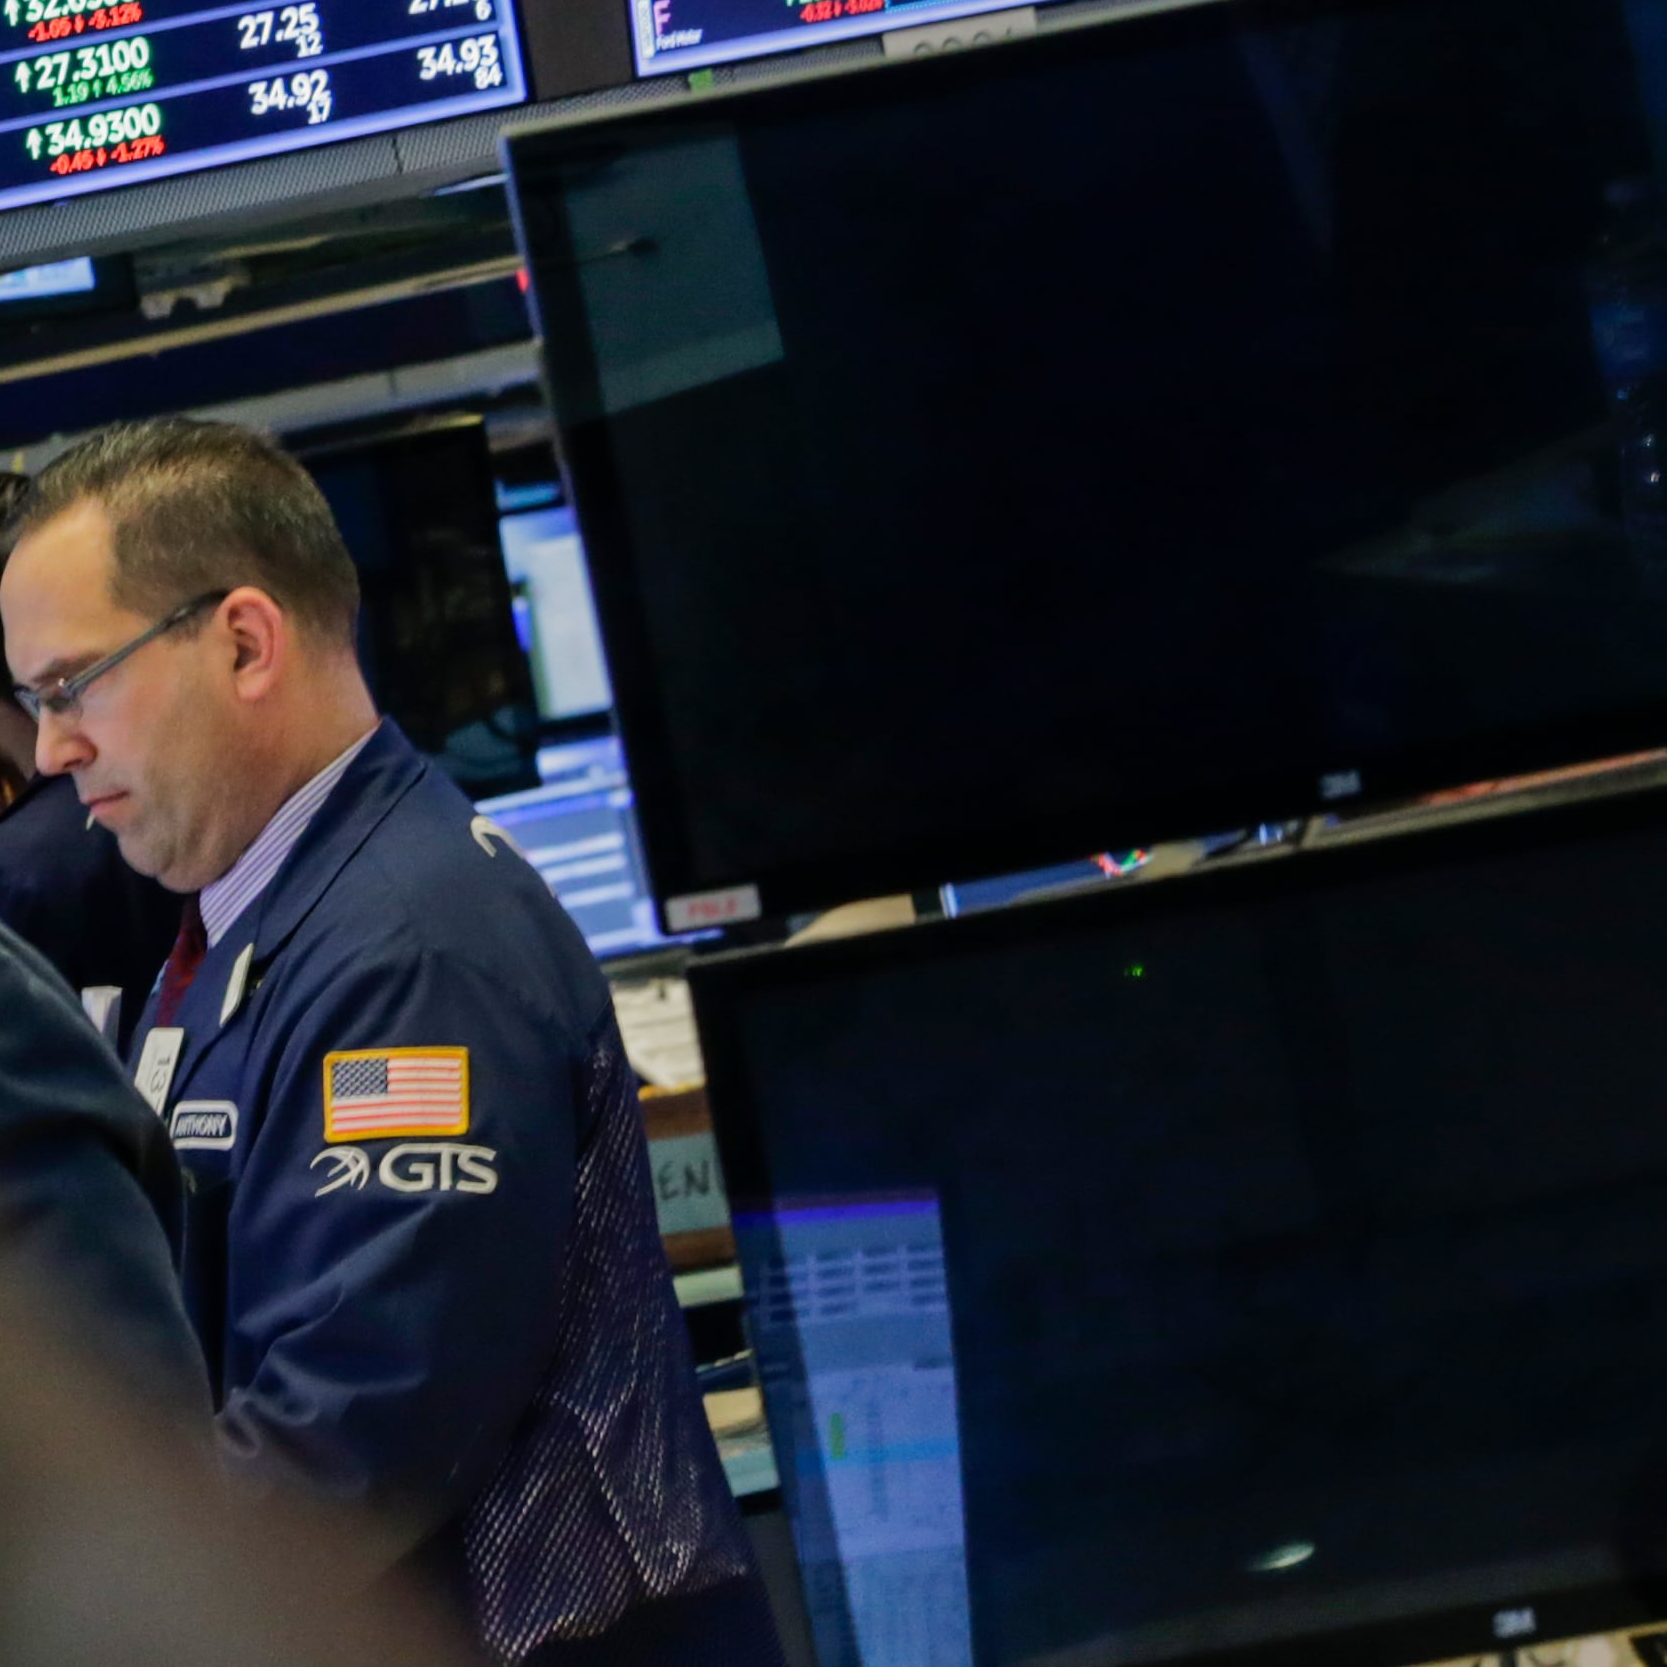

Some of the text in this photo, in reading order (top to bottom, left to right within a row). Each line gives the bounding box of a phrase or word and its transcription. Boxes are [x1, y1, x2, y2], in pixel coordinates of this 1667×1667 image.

[238, 2, 319, 50] 27.25
[653, 0, 671, 35] F
[34, 36, 149, 90] 27.3100
[296, 30, 323, 59] 12
[417, 33, 499, 81] 34.93
[248, 69, 331, 116] 34.92
[307, 96, 333, 125] 17
[45, 103, 161, 156] 34.9300
[175, 1114, 228, 1136] ANTHONY
[379, 1142, 498, 1195] GTS
